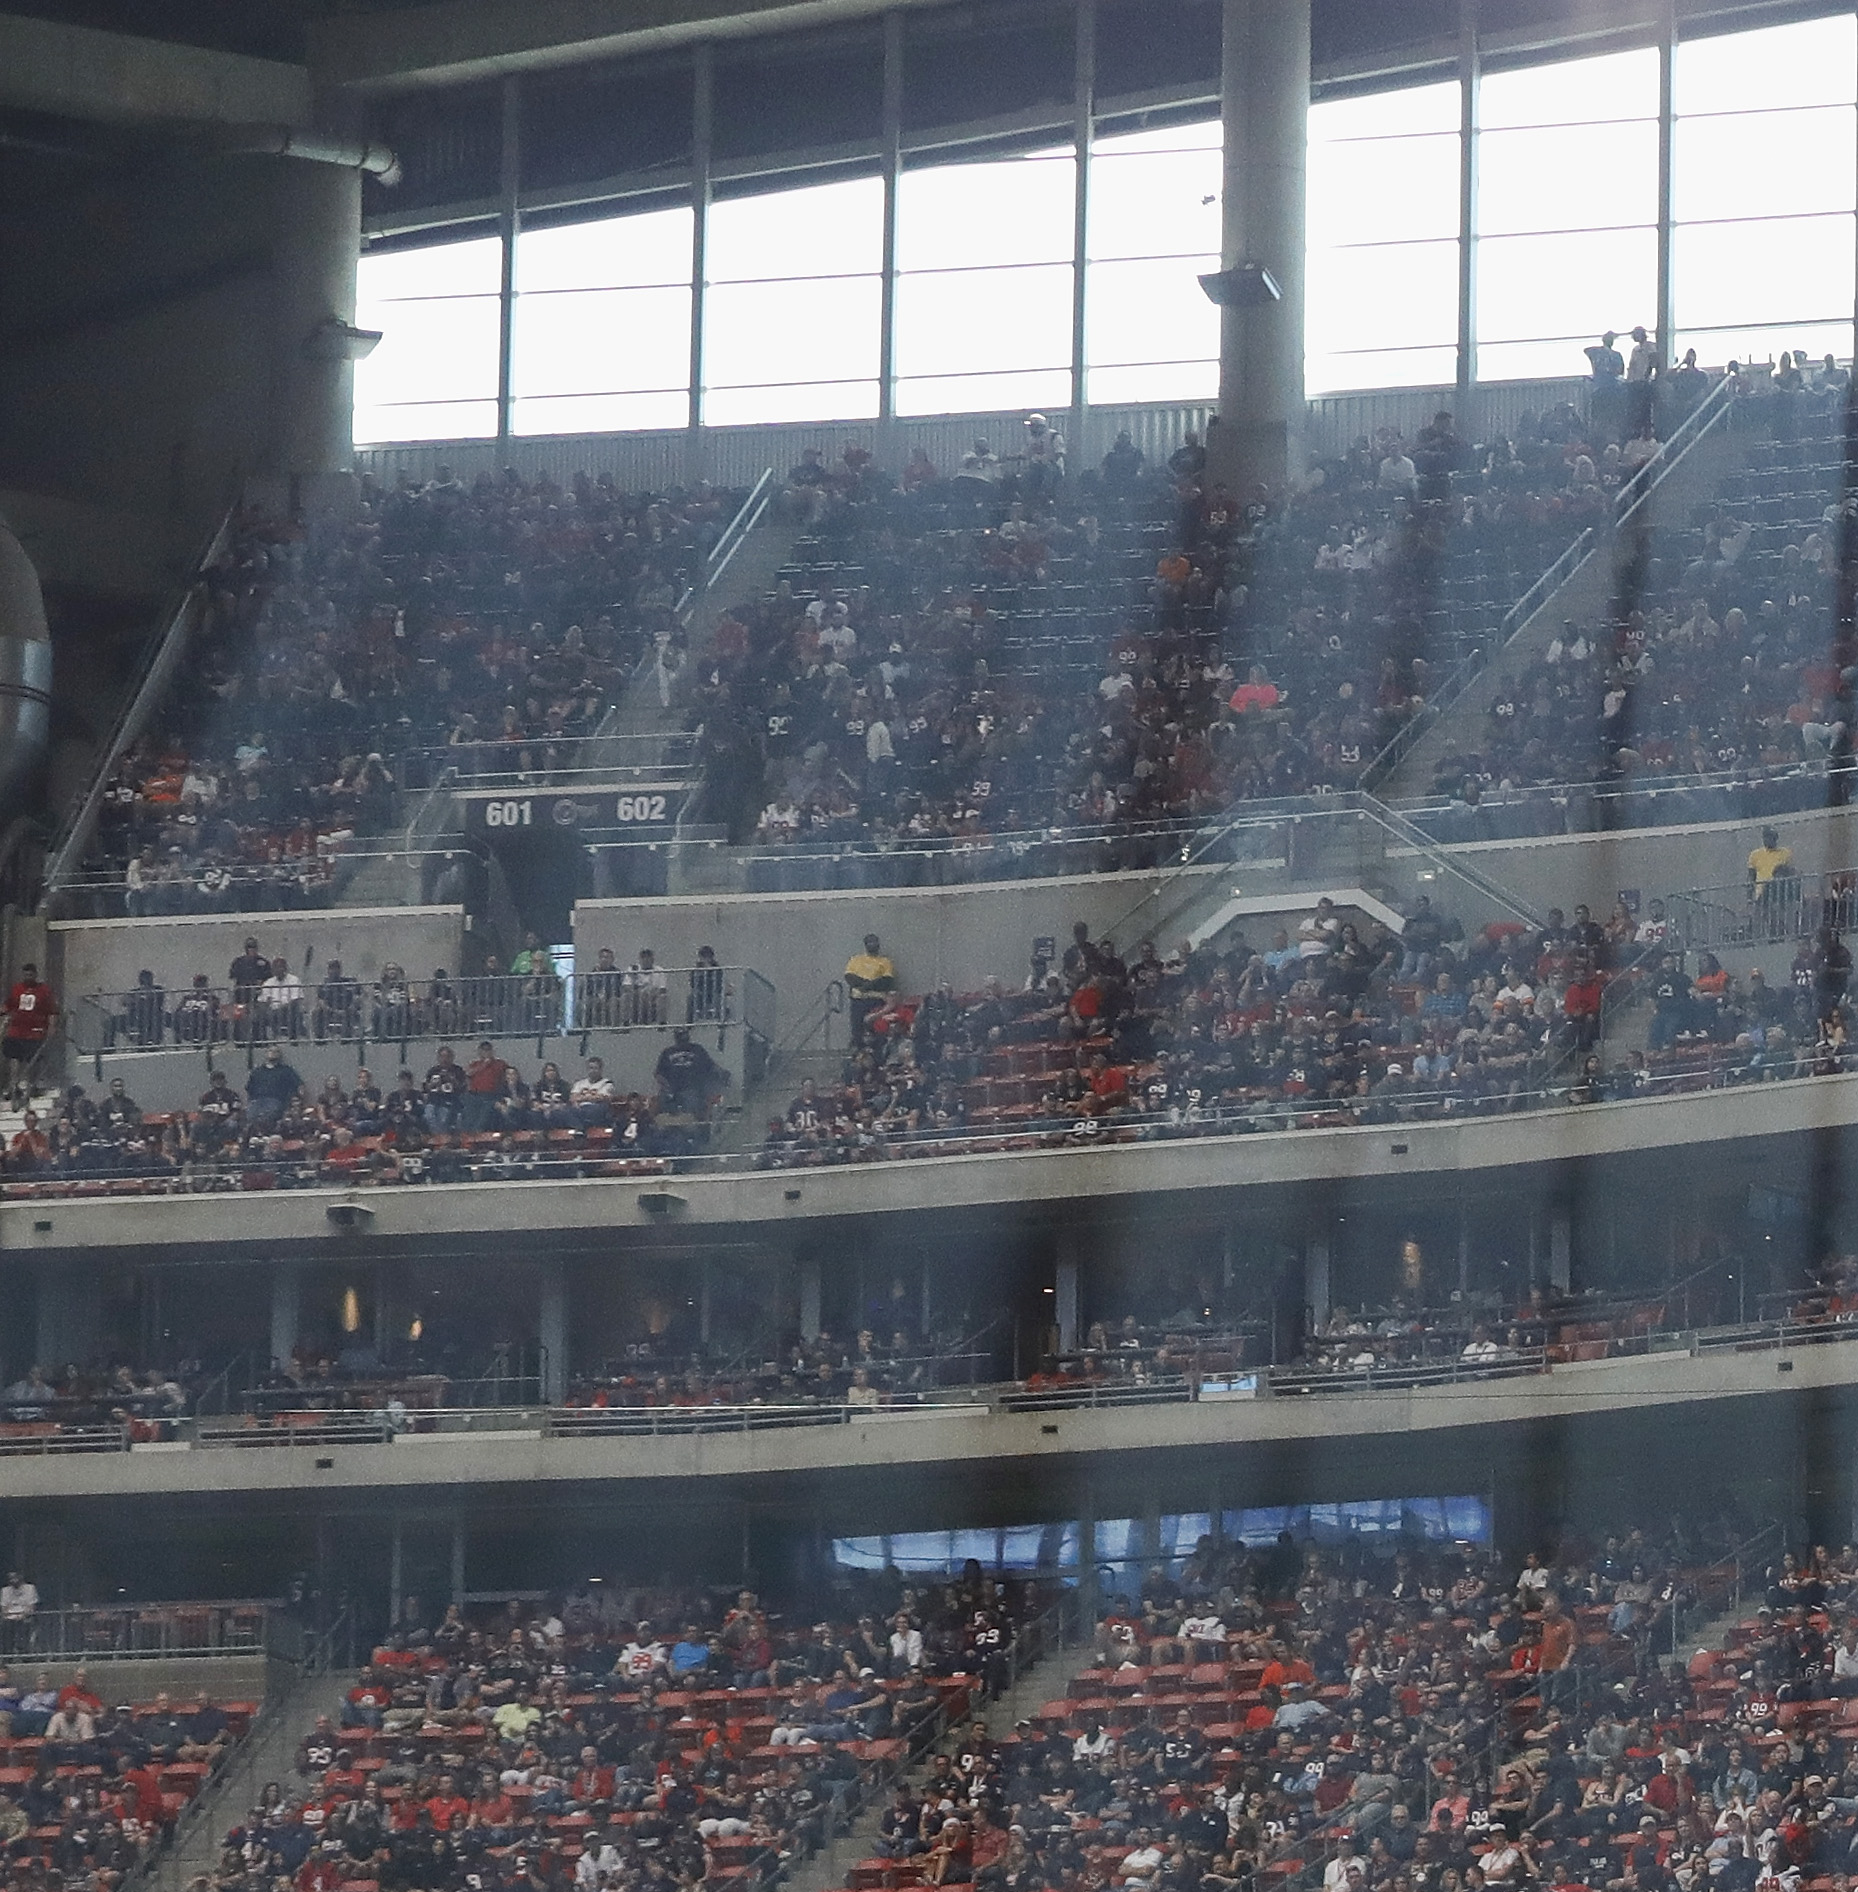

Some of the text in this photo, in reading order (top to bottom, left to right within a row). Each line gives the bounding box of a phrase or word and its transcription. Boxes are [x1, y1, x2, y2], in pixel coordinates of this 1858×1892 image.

[485, 801, 533, 827] 601
[617, 796, 667, 822] 602
[1750, 1702, 1769, 1717] 99
